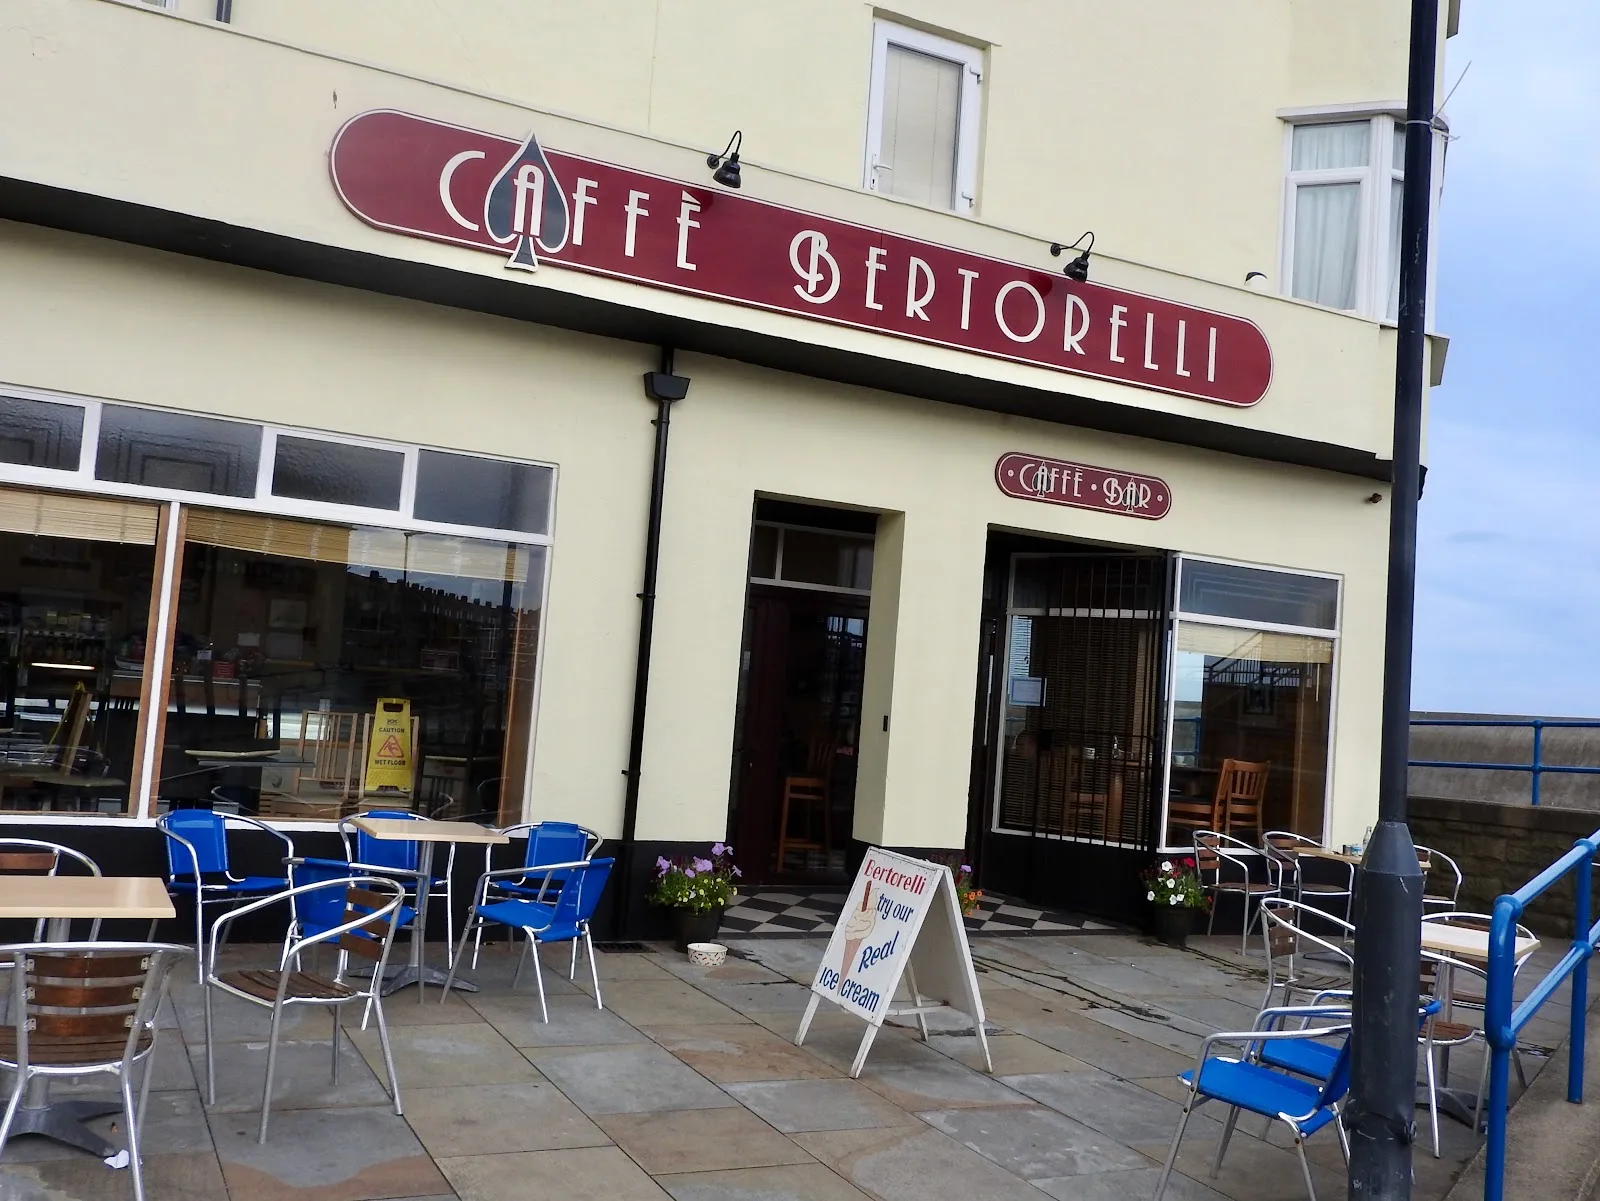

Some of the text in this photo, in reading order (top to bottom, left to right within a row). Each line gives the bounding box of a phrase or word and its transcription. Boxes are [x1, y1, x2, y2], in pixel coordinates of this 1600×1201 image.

[788, 229, 1218, 383] BERTORELLI
[1102, 477, 1151, 509] BAR
[863, 858, 927, 896] Bertorelli
[876, 892, 915, 923] try our
[857, 931, 900, 973] Real
[840, 978, 880, 1013] cream
